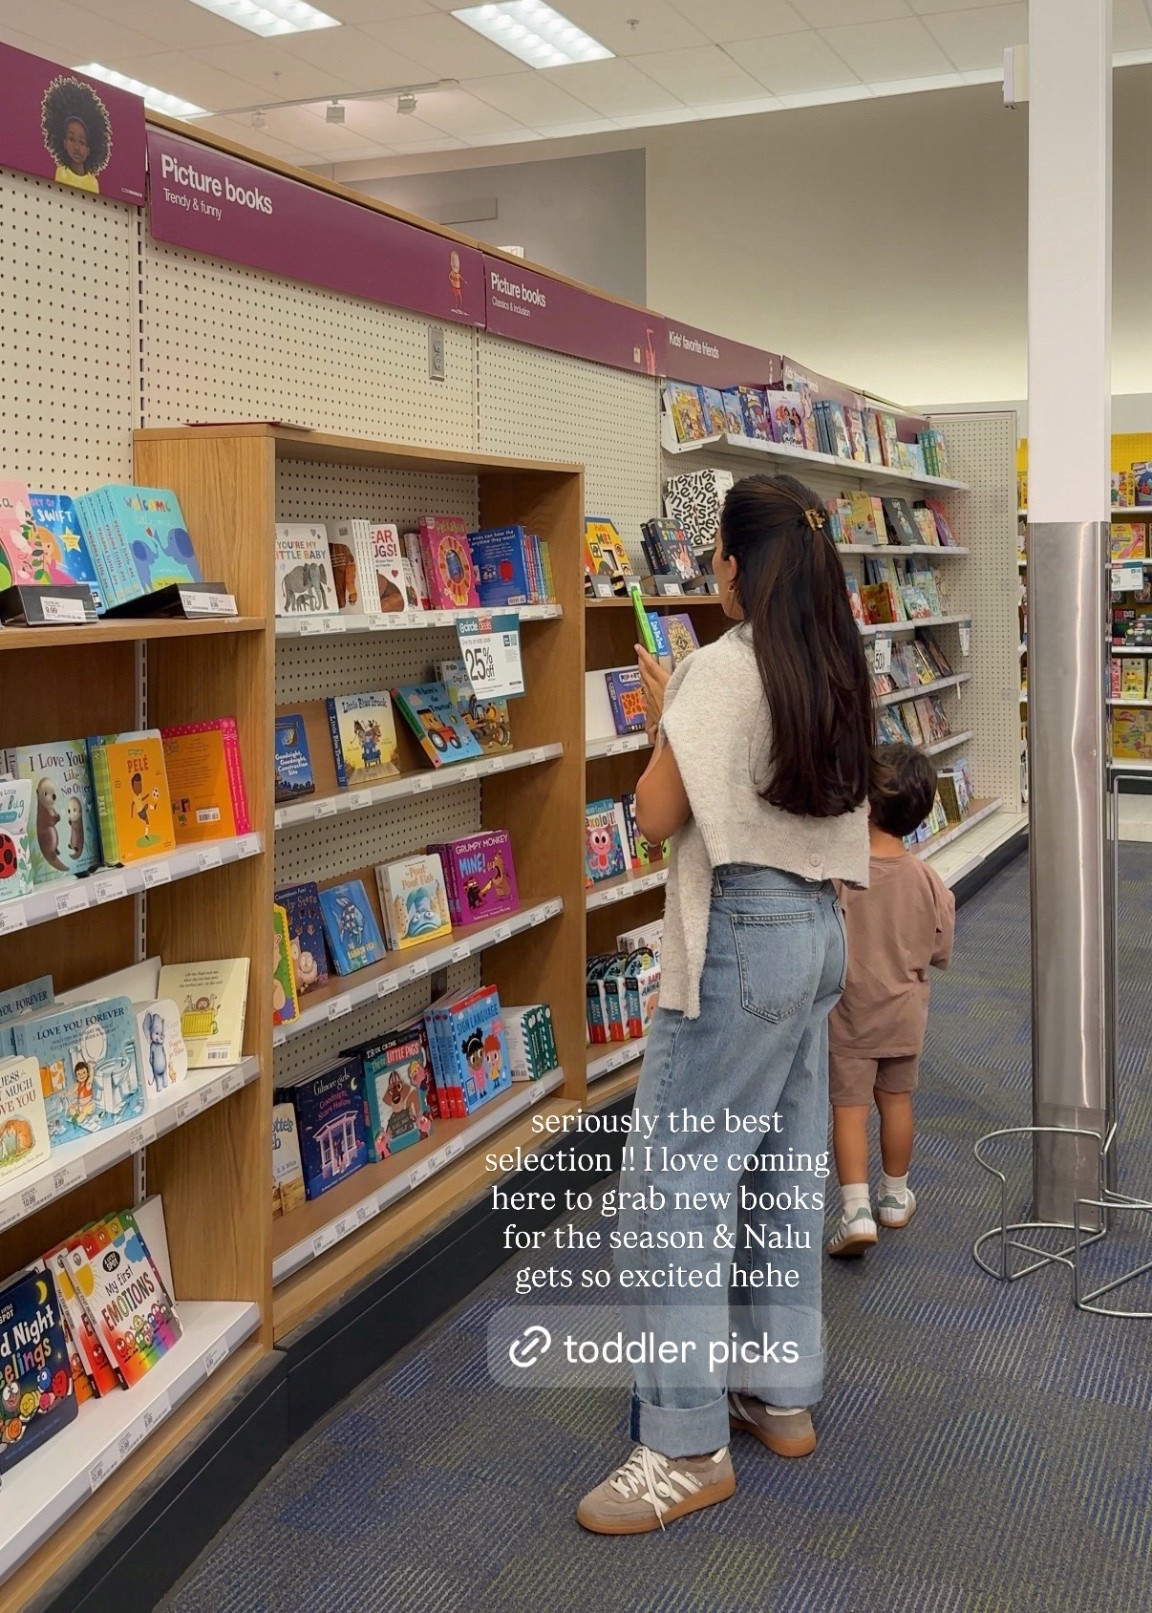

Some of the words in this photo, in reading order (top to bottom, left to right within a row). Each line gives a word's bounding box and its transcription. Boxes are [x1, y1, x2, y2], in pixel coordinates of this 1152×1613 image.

[161, 153, 222, 197] Picture
[225, 176, 273, 215] books
[163, 187, 191, 211] Trendy
[192, 197, 199, 211] &
[200, 200, 222, 221] funny
[490, 271, 521, 299] Picture
[521, 283, 546, 308] books
[668, 330, 682, 347] Kids'
[682, 335, 702, 354] favorite
[702, 341, 720, 359] friends
[36, 508, 73, 524] SWIFT
[277, 541, 305, 550] YOU'RE
[306, 540, 317, 549] MY
[371, 529, 394, 544] EAR
[276, 550, 302, 560] ITTLE
[303, 549, 327, 560] BABY
[485, 664, 495, 678] off
[29, 756, 35, 772] I
[38, 752, 65, 770] Love
[65, 751, 86, 767] You
[127, 755, 149, 773] PELÉ
[278, 762, 309, 773] Construction
[63, 769, 80, 783] Like
[61, 785, 72, 796] No
[72, 783, 91, 794] Otter
[7, 795, 25, 818] Bug
[455, 843, 482, 855] GRUMPY
[483, 833, 509, 847] MONKEY
[459, 853, 486, 878] MINE!
[16, 990, 48, 1011] FOREVER
[37, 1026, 61, 1041] LOVE
[63, 1020, 83, 1033] YOU
[85, 1007, 125, 1026] FOREVER
[456, 1019, 471, 1036] SIGN
[470, 1003, 499, 1030] LANGUAGE
[386, 1047, 405, 1064] LITTLE
[405, 1041, 420, 1058] PIGS
[5, 1077, 33, 1098] MUCH
[313, 1079, 337, 1096] Gilmore
[337, 1067, 351, 1090] girls
[16, 1089, 37, 1108] YOU
[107, 1257, 120, 1271] SPOT
[105, 1283, 119, 1297] My
[101, 1271, 155, 1332] EMOTIONS
[12, 1304, 54, 1351] Night
